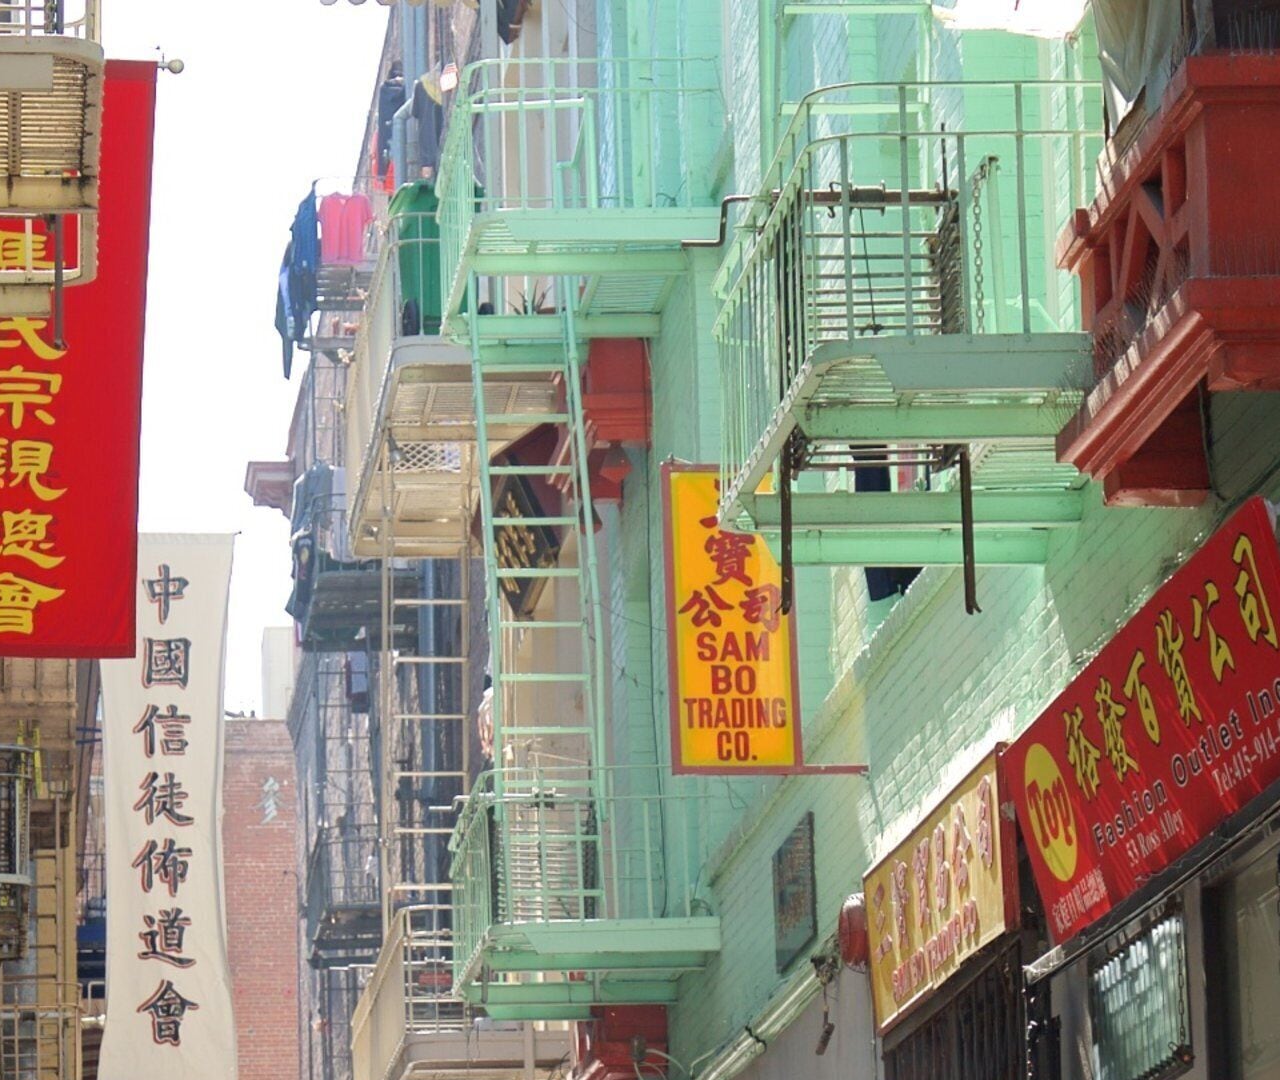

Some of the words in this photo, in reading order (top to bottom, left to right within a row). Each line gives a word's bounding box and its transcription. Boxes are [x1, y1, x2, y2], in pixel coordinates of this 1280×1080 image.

[678, 584, 782, 633] 公司
[696, 631, 770, 663] SAM
[710, 664, 756, 696] BO
[683, 698, 787, 730] TRADING
[716, 731, 758, 762] CO.
[1092, 779, 1168, 856] Fashion
[1171, 708, 1244, 788] Outlet
[131, 564, 198, 1048] 中國信徒佈道會
[1026, 778, 1076, 850] Top
